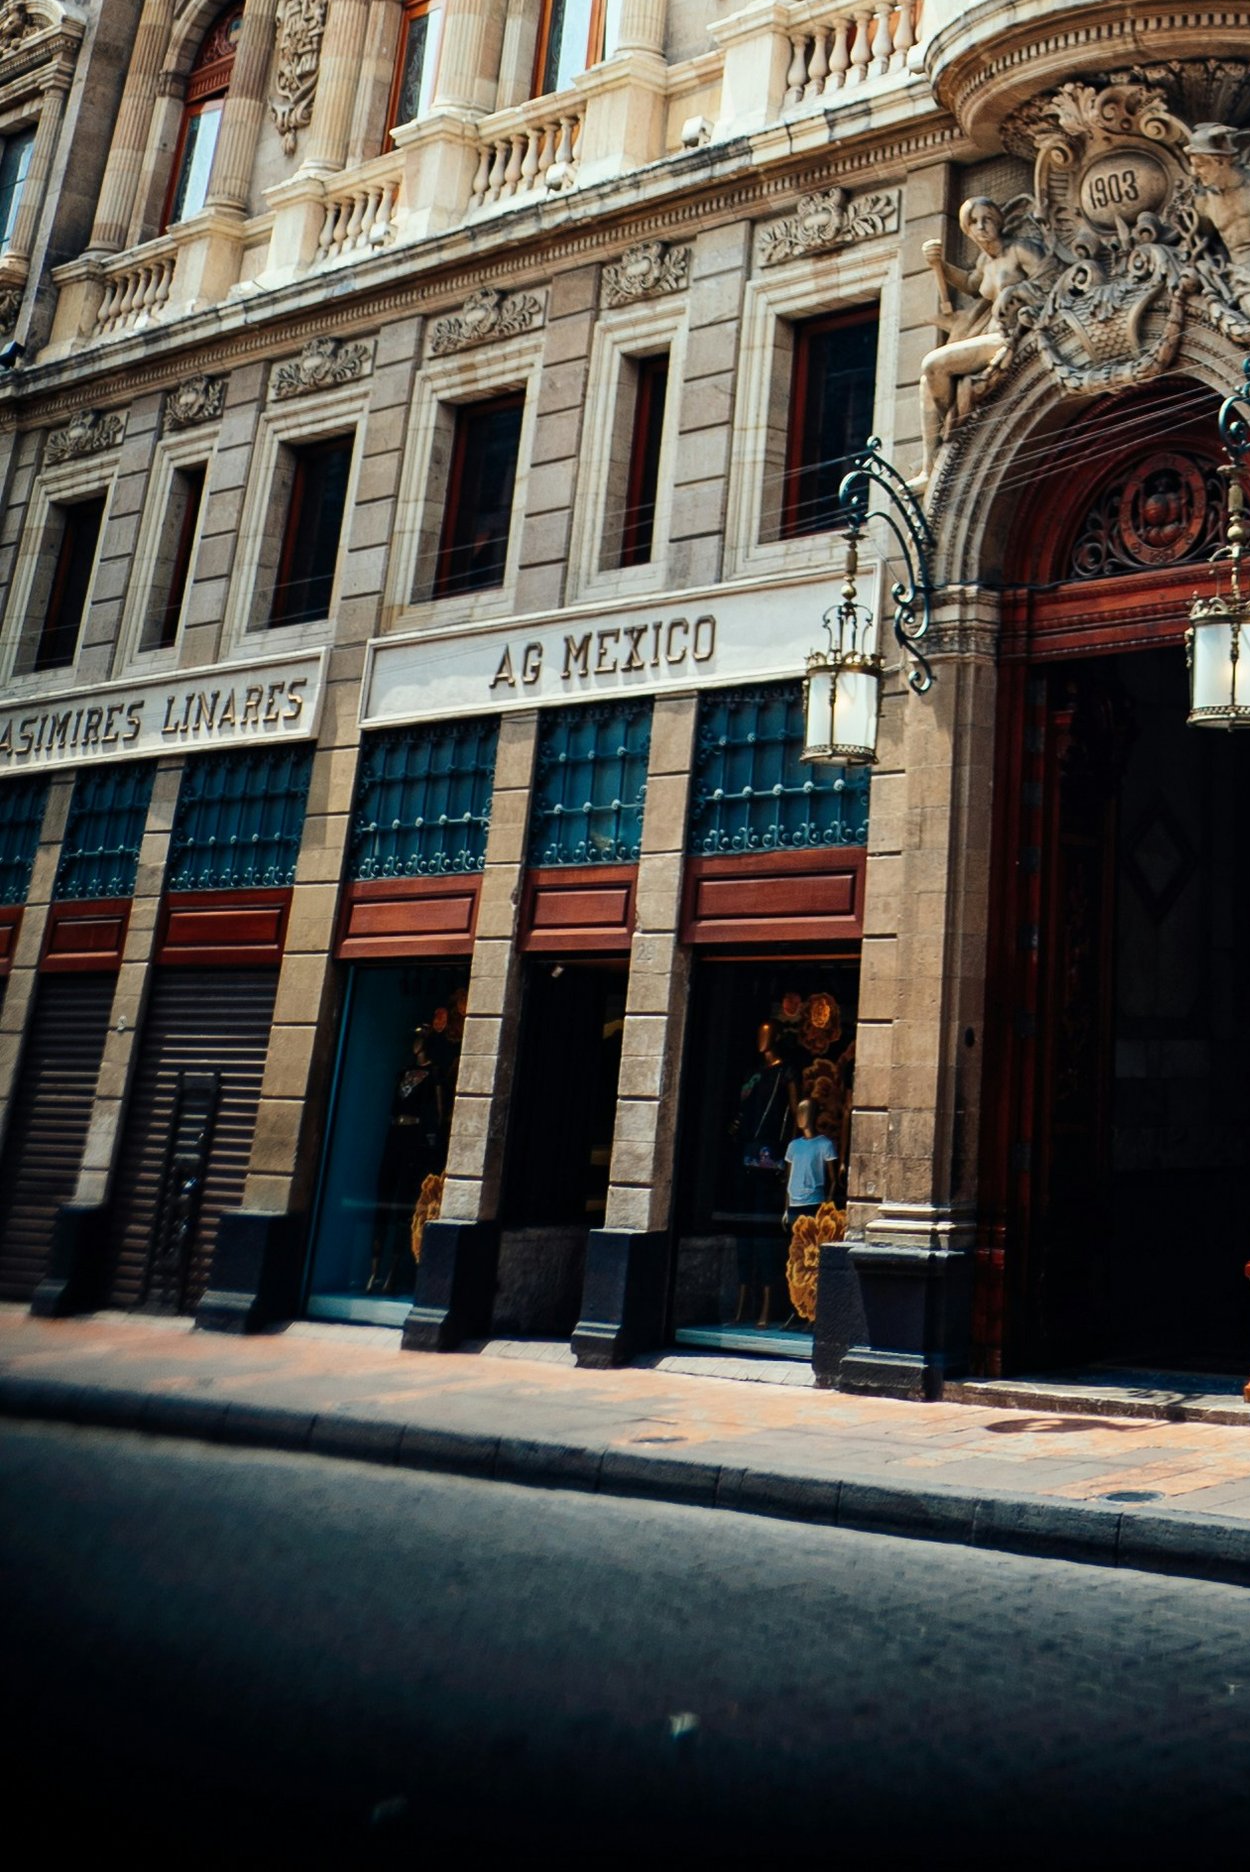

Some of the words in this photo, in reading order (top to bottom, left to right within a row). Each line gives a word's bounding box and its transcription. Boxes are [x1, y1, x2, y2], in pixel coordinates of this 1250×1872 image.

[1089, 169, 1139, 209] 1903
[489, 641, 544, 689] AG
[561, 614, 717, 679] MEXICO
[0, 699, 145, 757] ASIMIRES
[161, 678, 308, 734] LINARES
